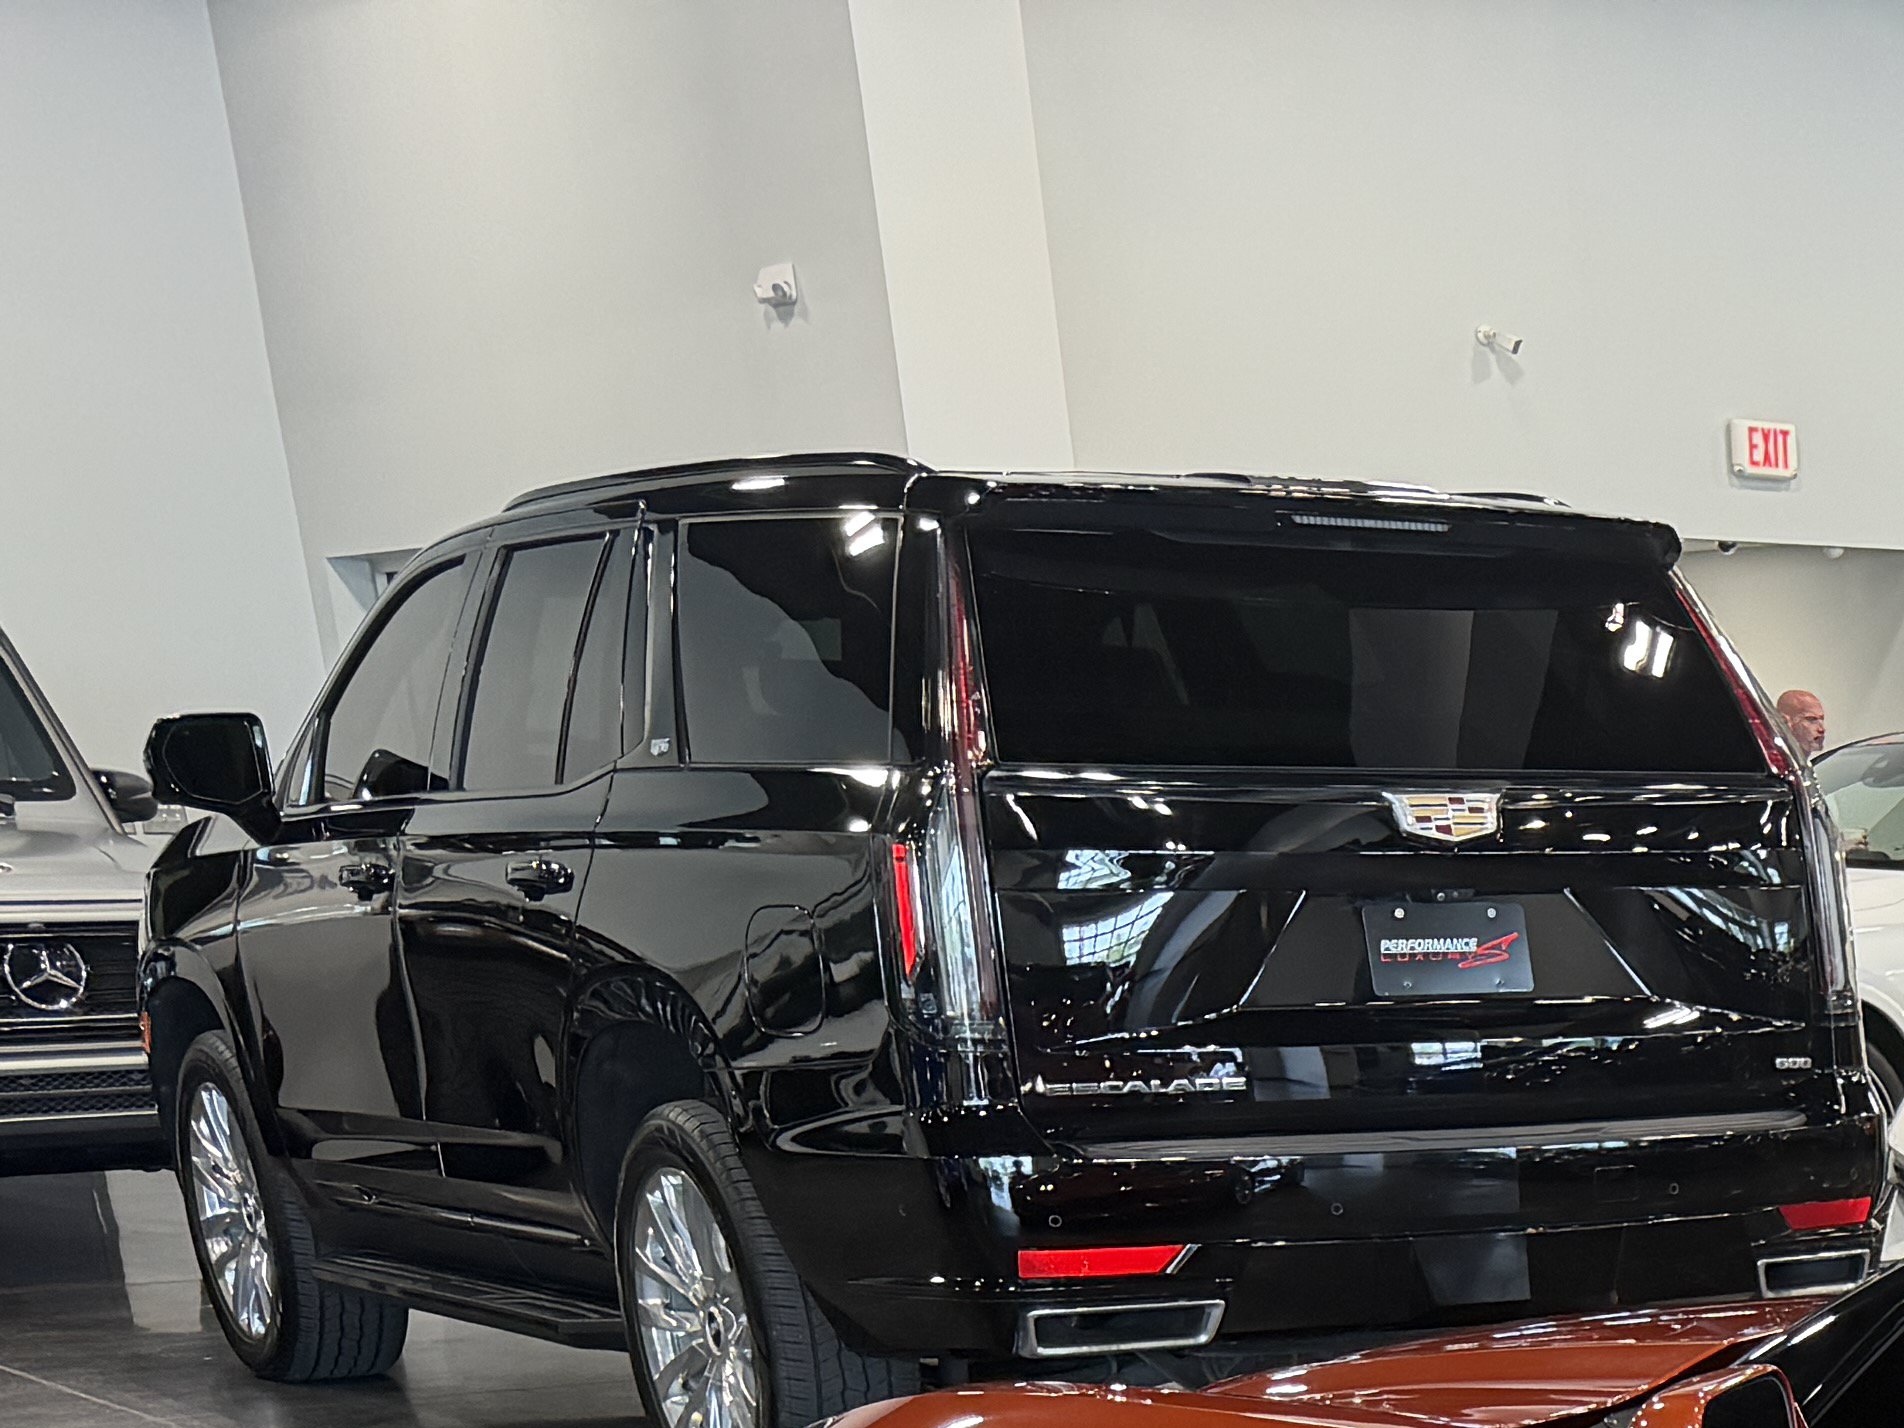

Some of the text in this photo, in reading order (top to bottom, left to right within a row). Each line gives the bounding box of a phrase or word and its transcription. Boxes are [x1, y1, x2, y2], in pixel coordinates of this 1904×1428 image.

[1747, 426, 1790, 469] EXIT
[1380, 937, 1478, 953] PERFORMANCE
[1775, 1057, 1812, 1069] 600
[1045, 1077, 1247, 1096] ESCALADE
